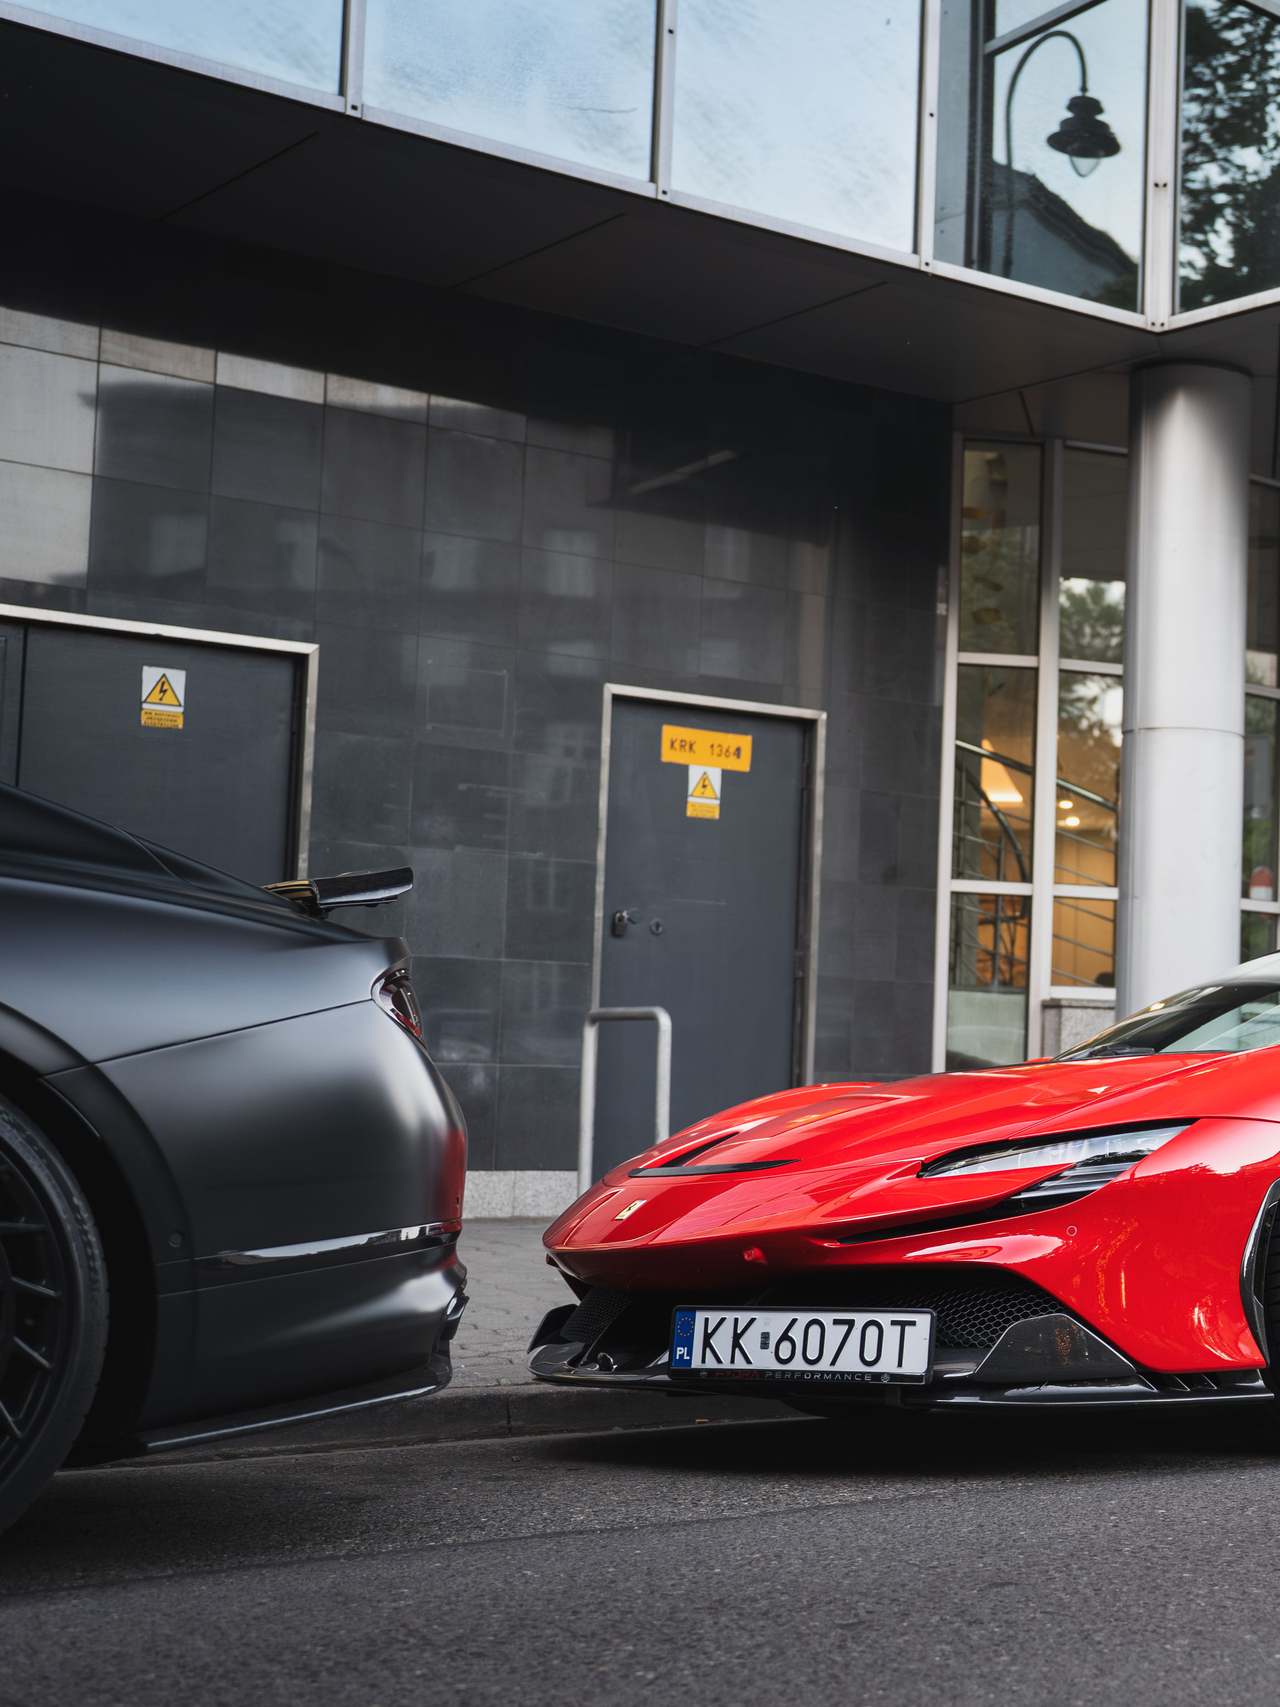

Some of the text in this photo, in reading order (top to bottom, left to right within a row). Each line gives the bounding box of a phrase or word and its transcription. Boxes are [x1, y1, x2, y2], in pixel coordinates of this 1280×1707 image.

[670, 738, 742, 760] KRK 1364
[701, 1316, 917, 1368] KK 6070T
[676, 1346, 690, 1360] PL
[716, 1370, 872, 1381] HYDRA PERFORMANCE
